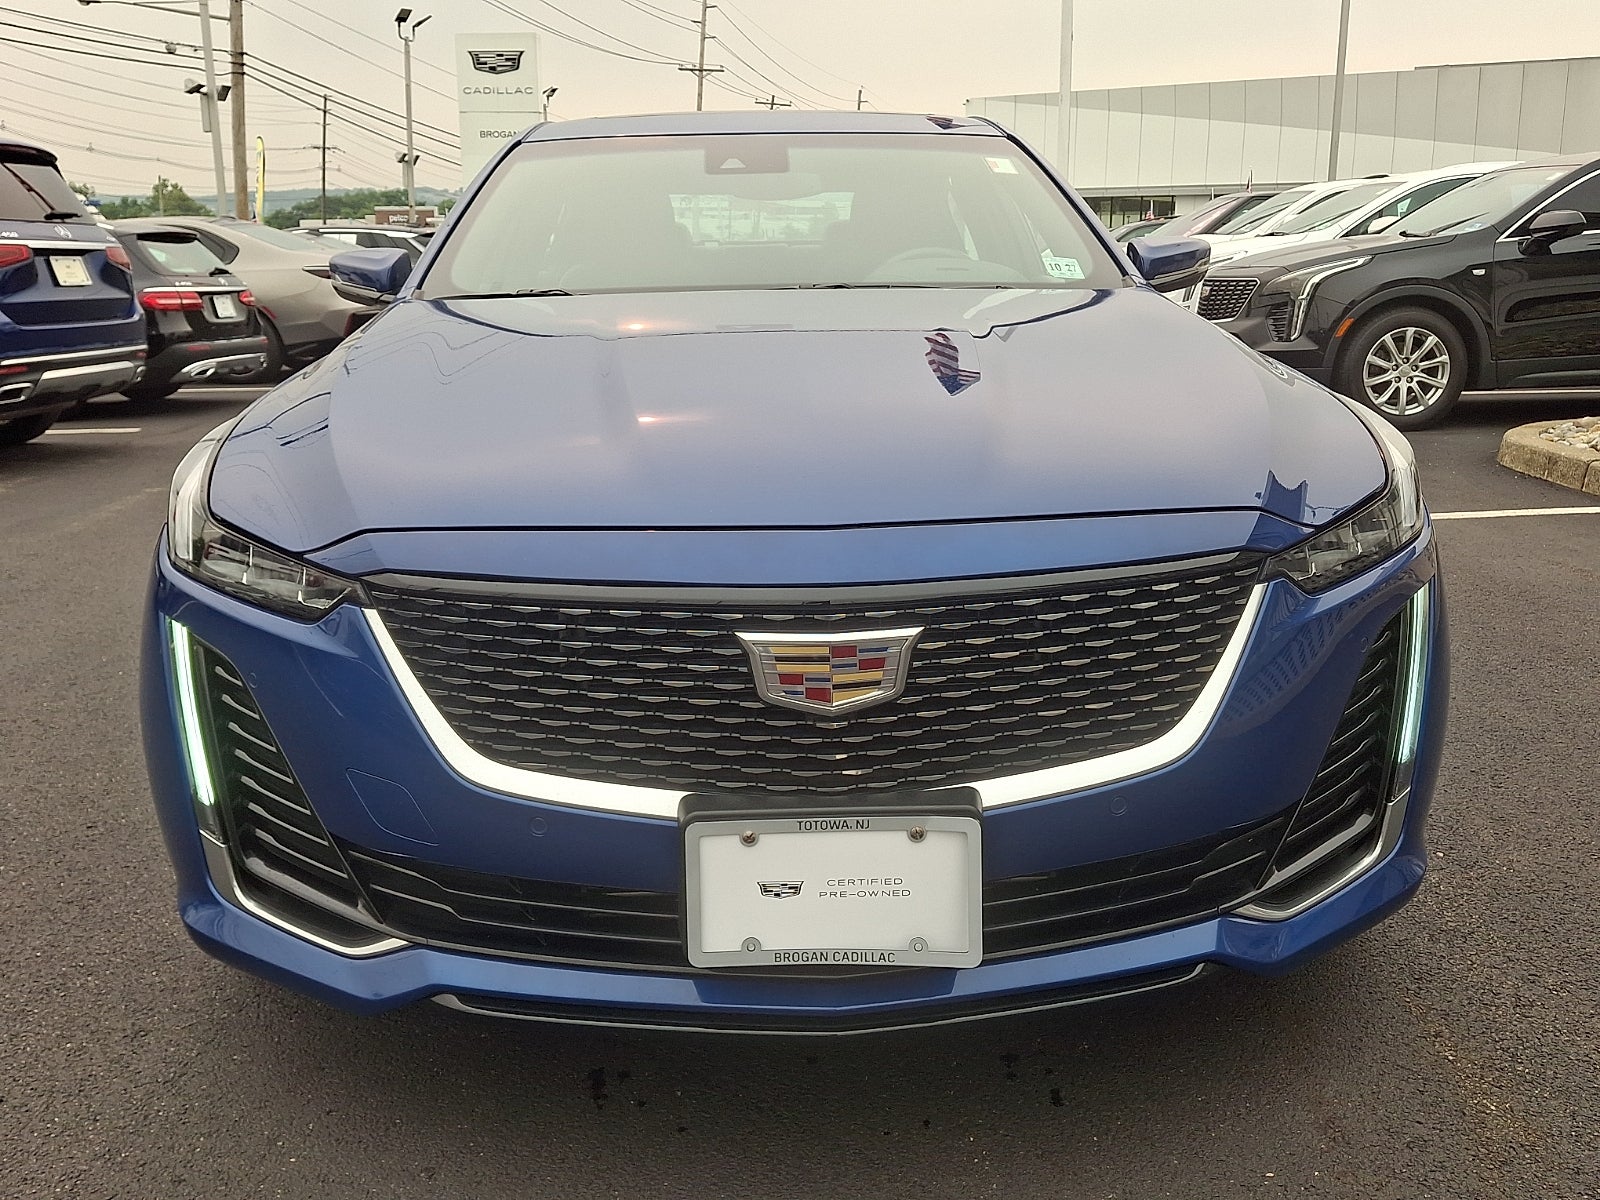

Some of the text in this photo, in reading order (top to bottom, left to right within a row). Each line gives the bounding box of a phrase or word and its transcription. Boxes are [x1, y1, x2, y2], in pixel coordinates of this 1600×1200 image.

[462, 86, 534, 95] CADILLAC
[1048, 263, 1062, 272] 10
[855, 819, 870, 830] NJ
[826, 878, 903, 887] CERTIFIED
[819, 889, 911, 898] PRE-OWNED
[774, 951, 896, 963] BROGAN CADILLAC
